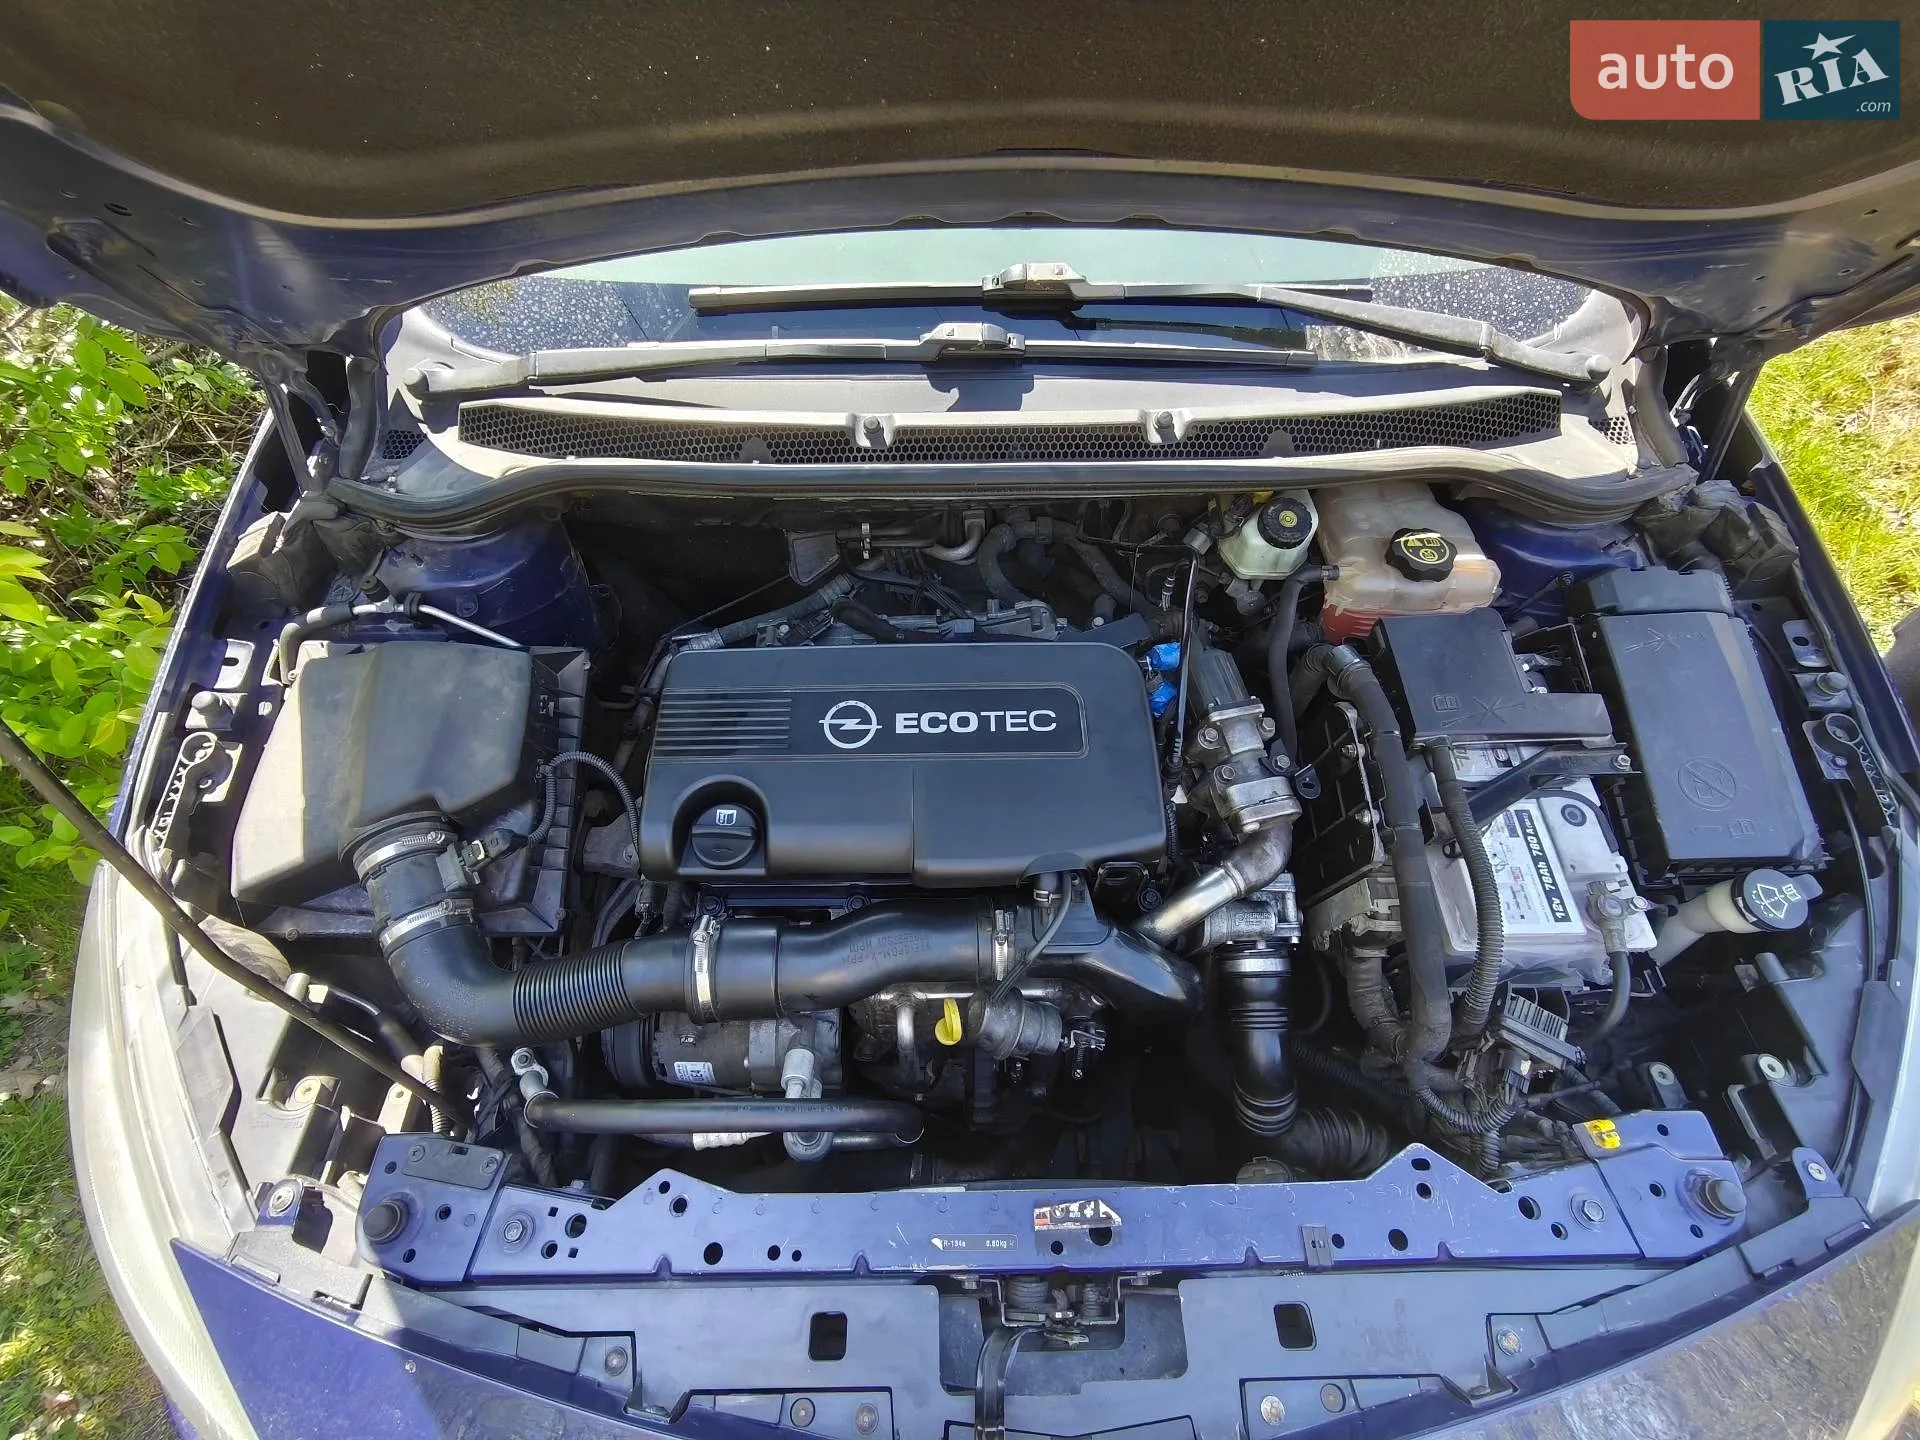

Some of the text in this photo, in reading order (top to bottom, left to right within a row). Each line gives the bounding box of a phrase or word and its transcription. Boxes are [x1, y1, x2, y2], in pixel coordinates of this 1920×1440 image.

[895, 709, 1057, 734] ECOTEC
[1528, 836, 1543, 856] 780
[1538, 861, 1556, 891] 78Ah
